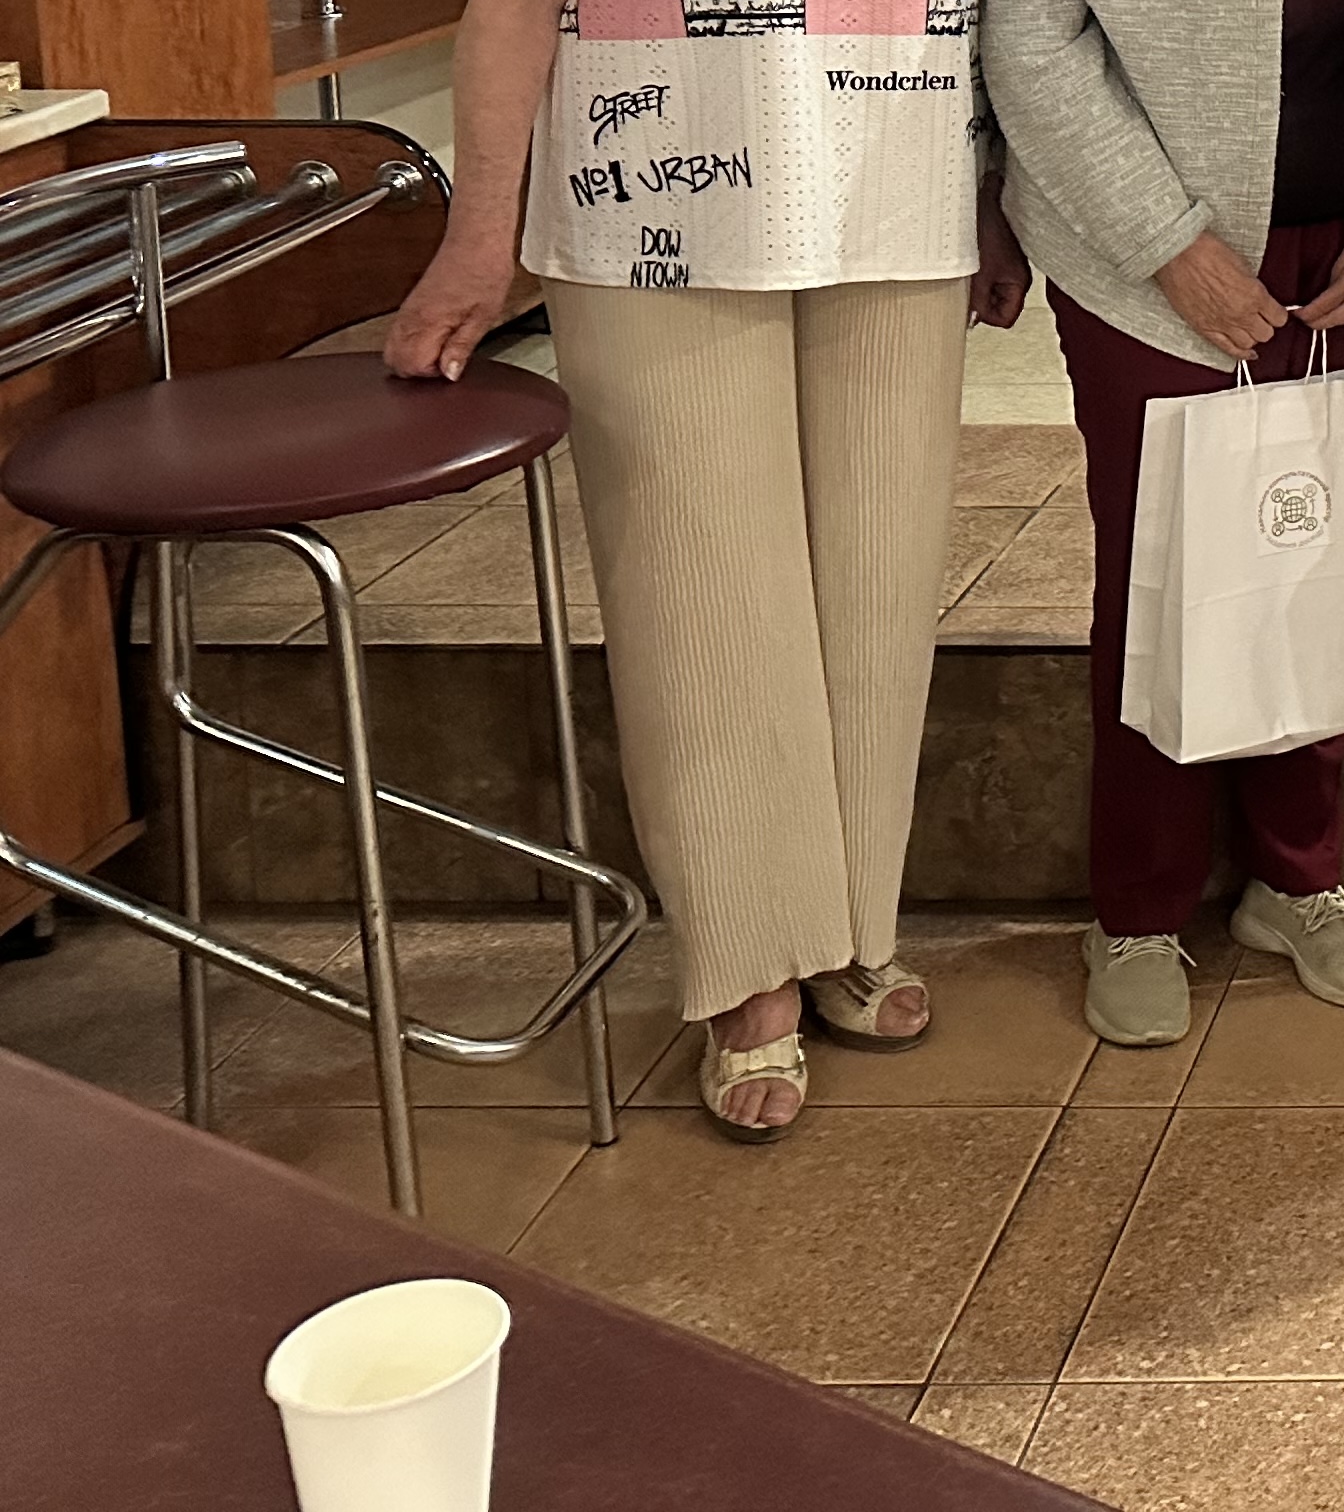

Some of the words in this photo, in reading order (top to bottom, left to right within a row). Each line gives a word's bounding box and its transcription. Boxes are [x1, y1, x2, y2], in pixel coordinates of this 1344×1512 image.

[589, 85, 671, 146] STREET
[637, 146, 753, 194] URBAN
[641, 225, 681, 258] DOW
[630, 260, 689, 289] NTOWN
